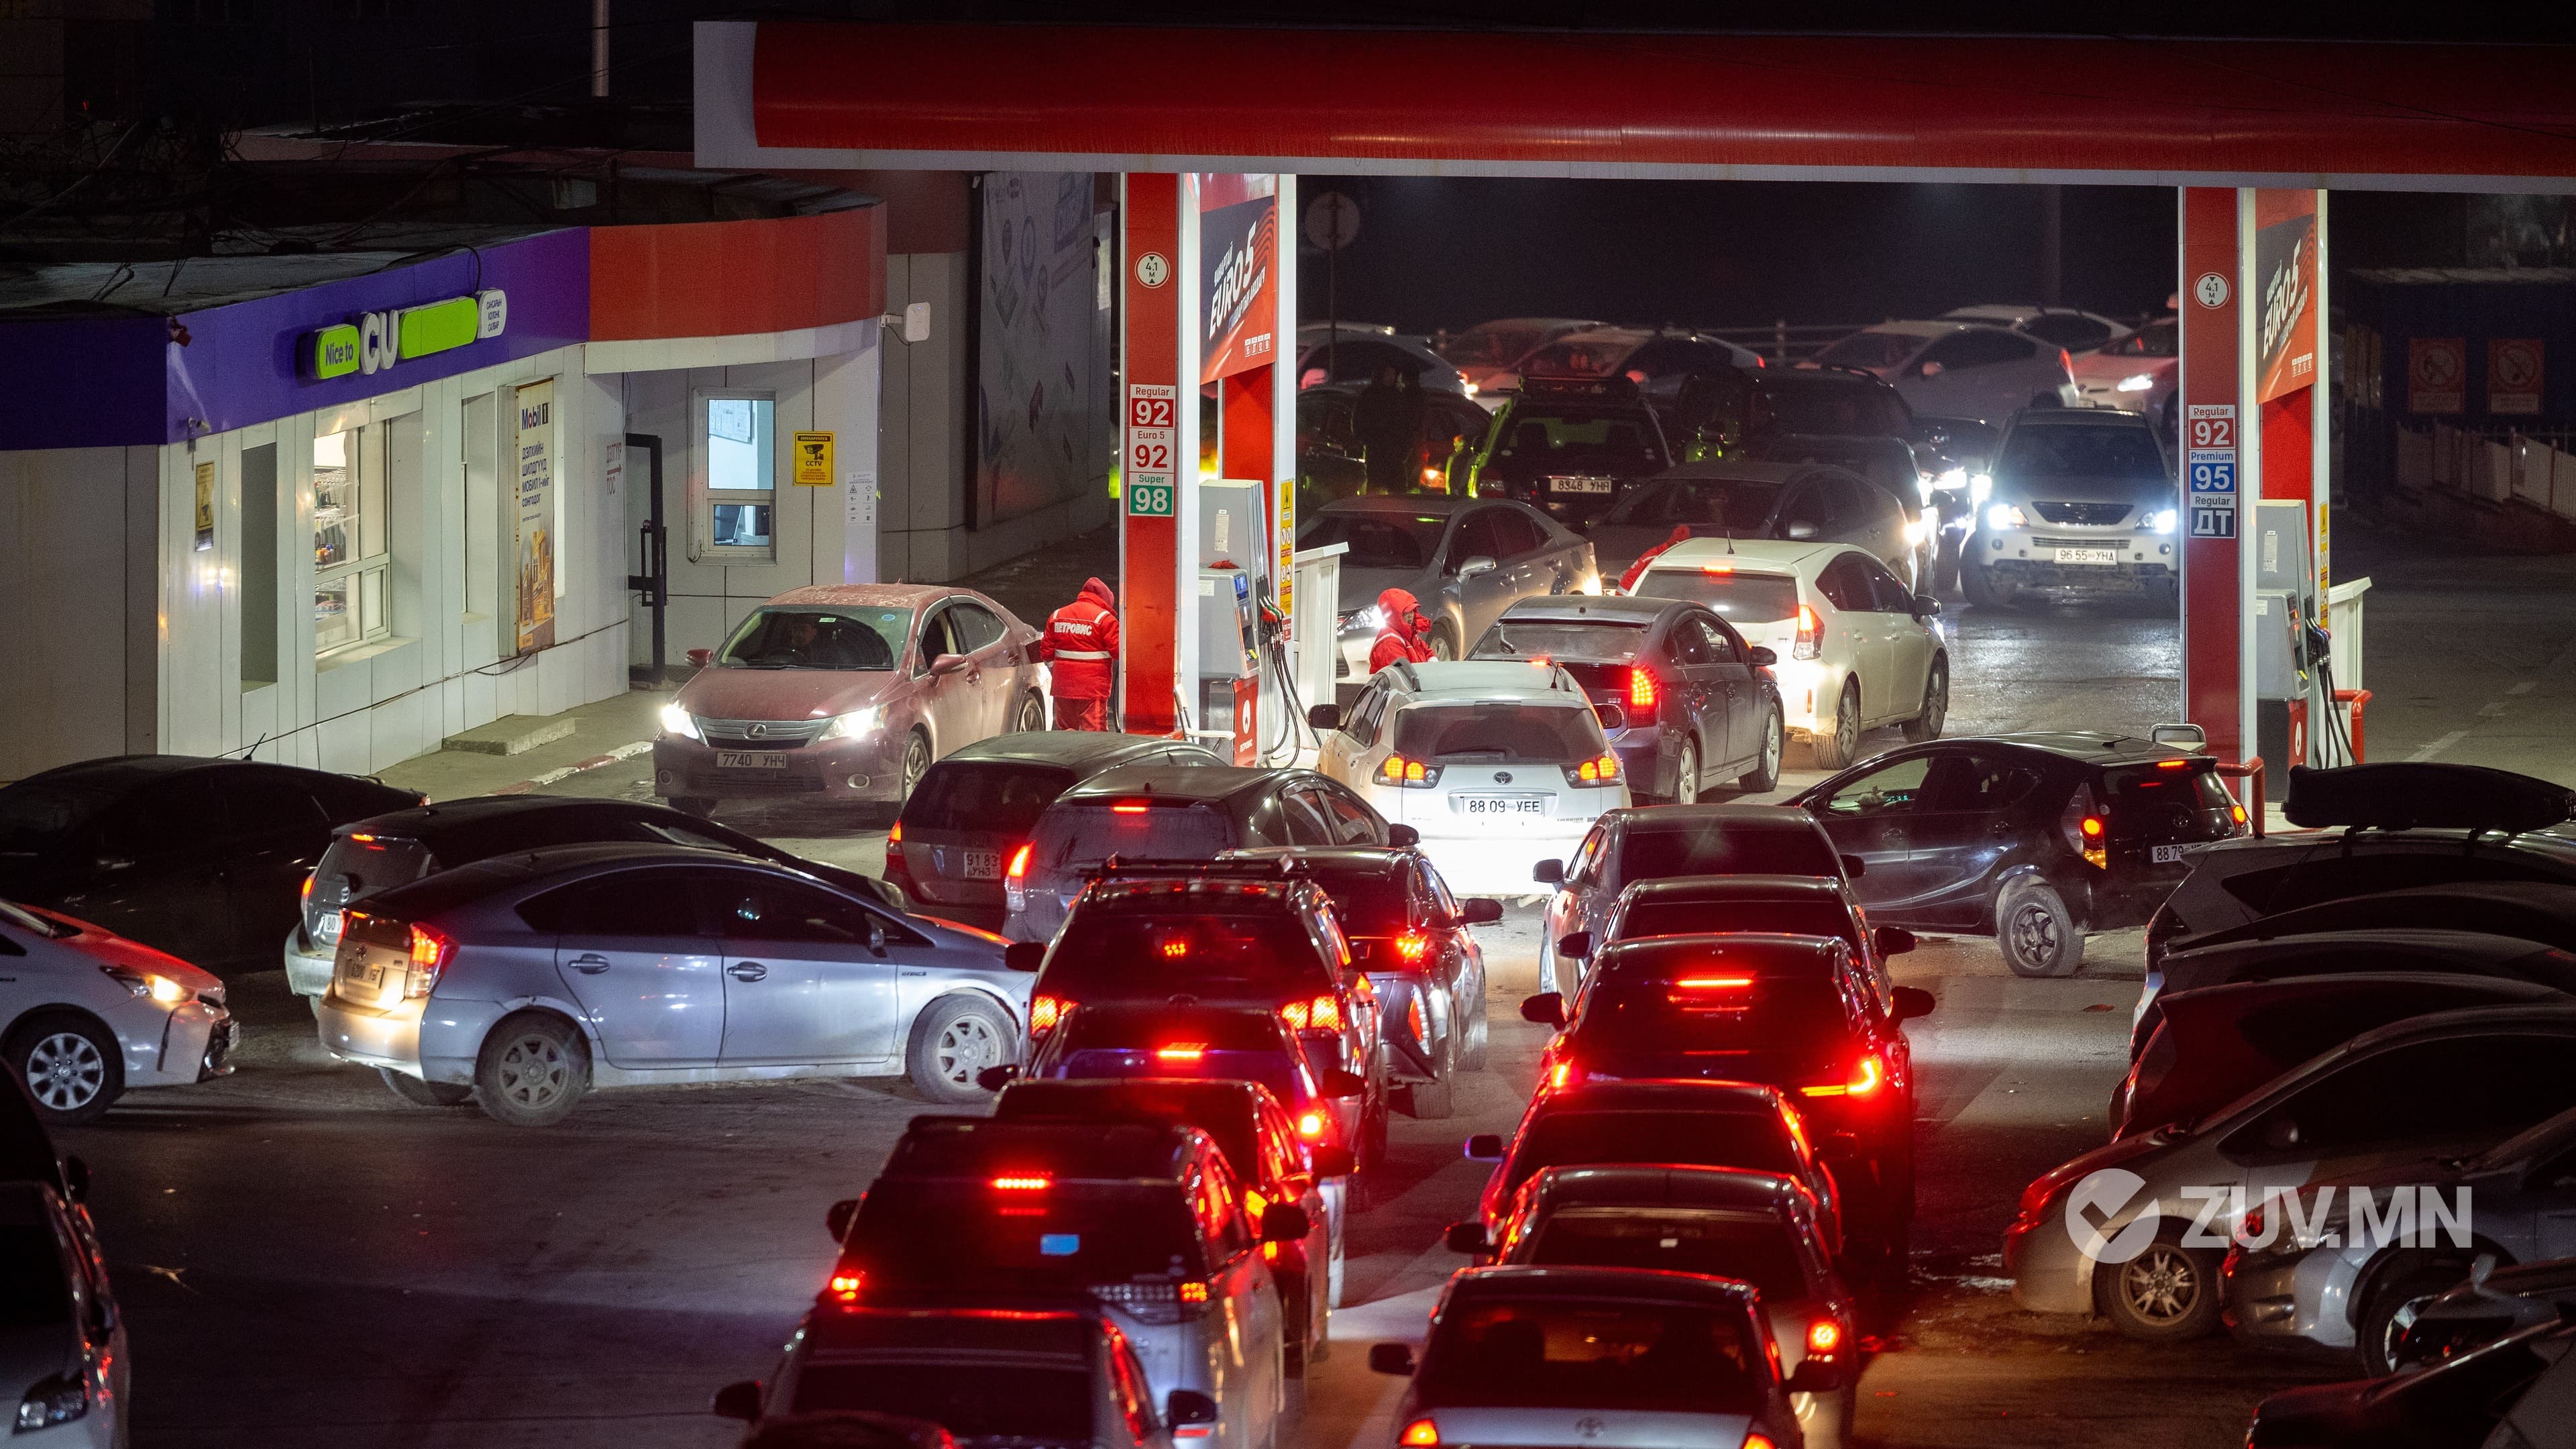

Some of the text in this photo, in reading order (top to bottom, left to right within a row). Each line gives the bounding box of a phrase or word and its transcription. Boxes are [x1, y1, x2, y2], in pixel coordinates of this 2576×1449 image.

[1145, 262, 1158, 271] 4.1
[2205, 282, 2218, 292] 4.1
[360, 309, 399, 375] CU
[325, 341, 354, 366] Nice to
[1136, 386, 1170, 398] Regular
[522, 405, 541, 431] Mobil
[1136, 400, 1169, 425] 92
[2194, 407, 2229, 418] Regular
[1138, 431, 1165, 439] Euro 5
[2195, 421, 2230, 445] 92
[1135, 444, 1168, 468] 92
[2191, 451, 2233, 461] Premium
[1138, 474, 1165, 484] Super
[2195, 466, 2230, 490] 95
[1590, 481, 1609, 491] УНА
[1135, 488, 1168, 512] 98
[2195, 496, 2231, 506] Regular
[2194, 510, 2232, 535] ДТ
[2060, 549, 2072, 559] 96
[2076, 550, 2088, 560] 55
[1054, 622, 1092, 636] ПЕТРОВИС
[723, 754, 785, 767] 7740 УНЧ
[1470, 800, 1540, 812] 88 09 УЕЕ
[2157, 847, 2169, 861] 88
